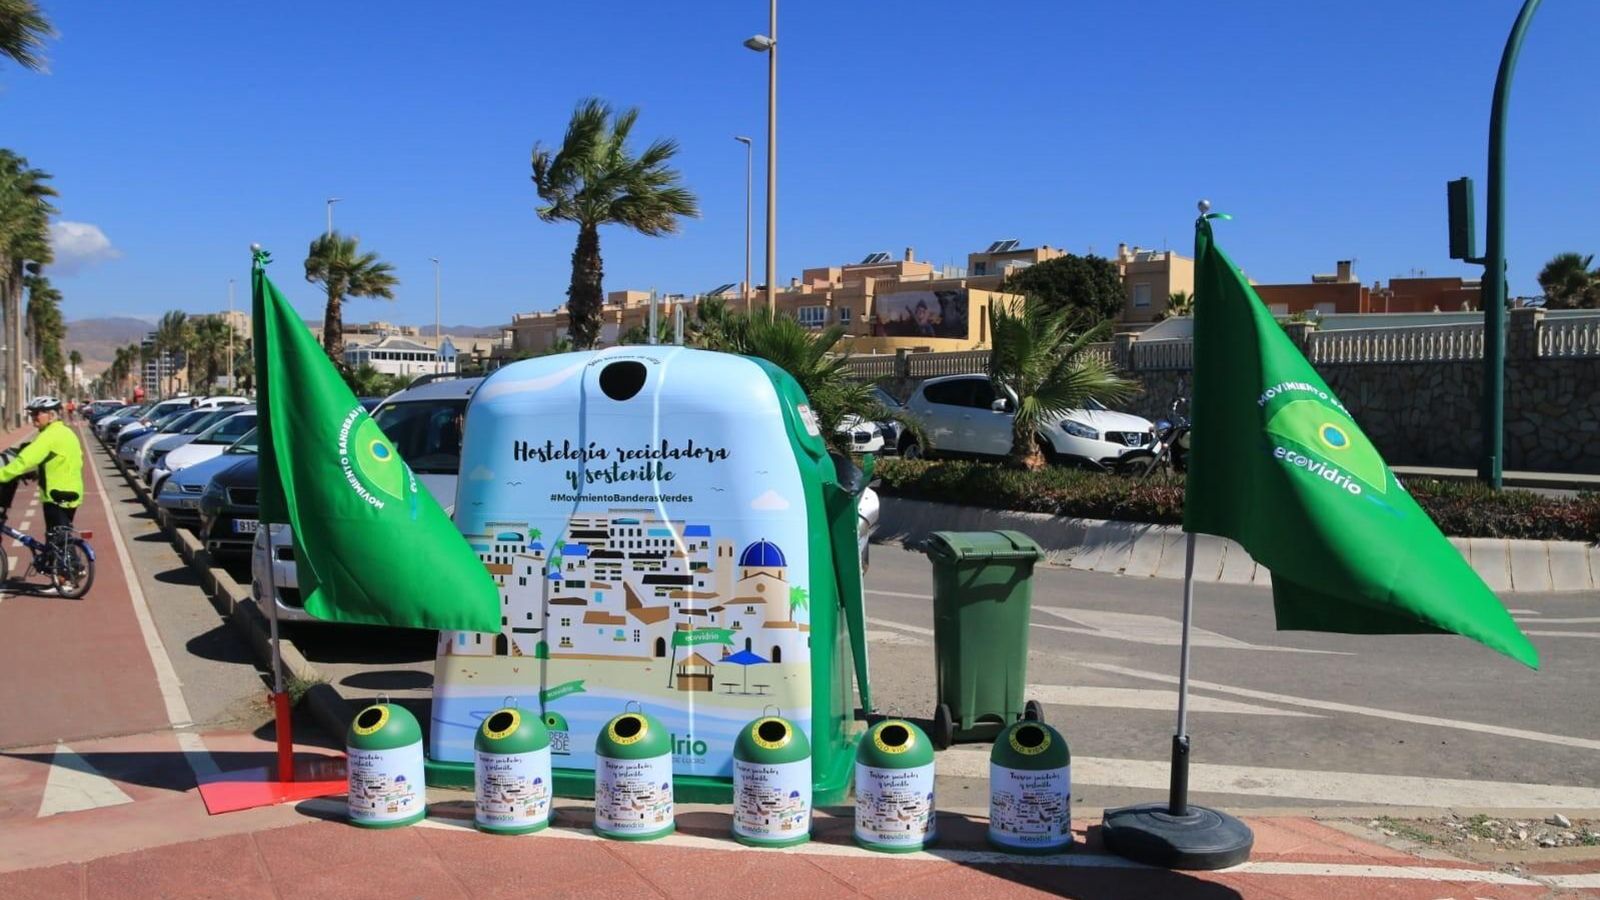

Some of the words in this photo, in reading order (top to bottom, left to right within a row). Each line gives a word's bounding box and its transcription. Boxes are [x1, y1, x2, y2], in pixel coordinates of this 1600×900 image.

[1257, 382, 1328, 406] MOVIMIENTO
[513, 439, 611, 464] Hostelería
[616, 438, 731, 463] recicladora
[341, 456, 385, 509] MOVIMIENTO
[565, 467, 578, 491] y
[585, 461, 677, 483] sostenible
[1273, 446, 1362, 495] ecovidrio
[550, 493, 694, 503] #MovimientoBanderasVerdes
